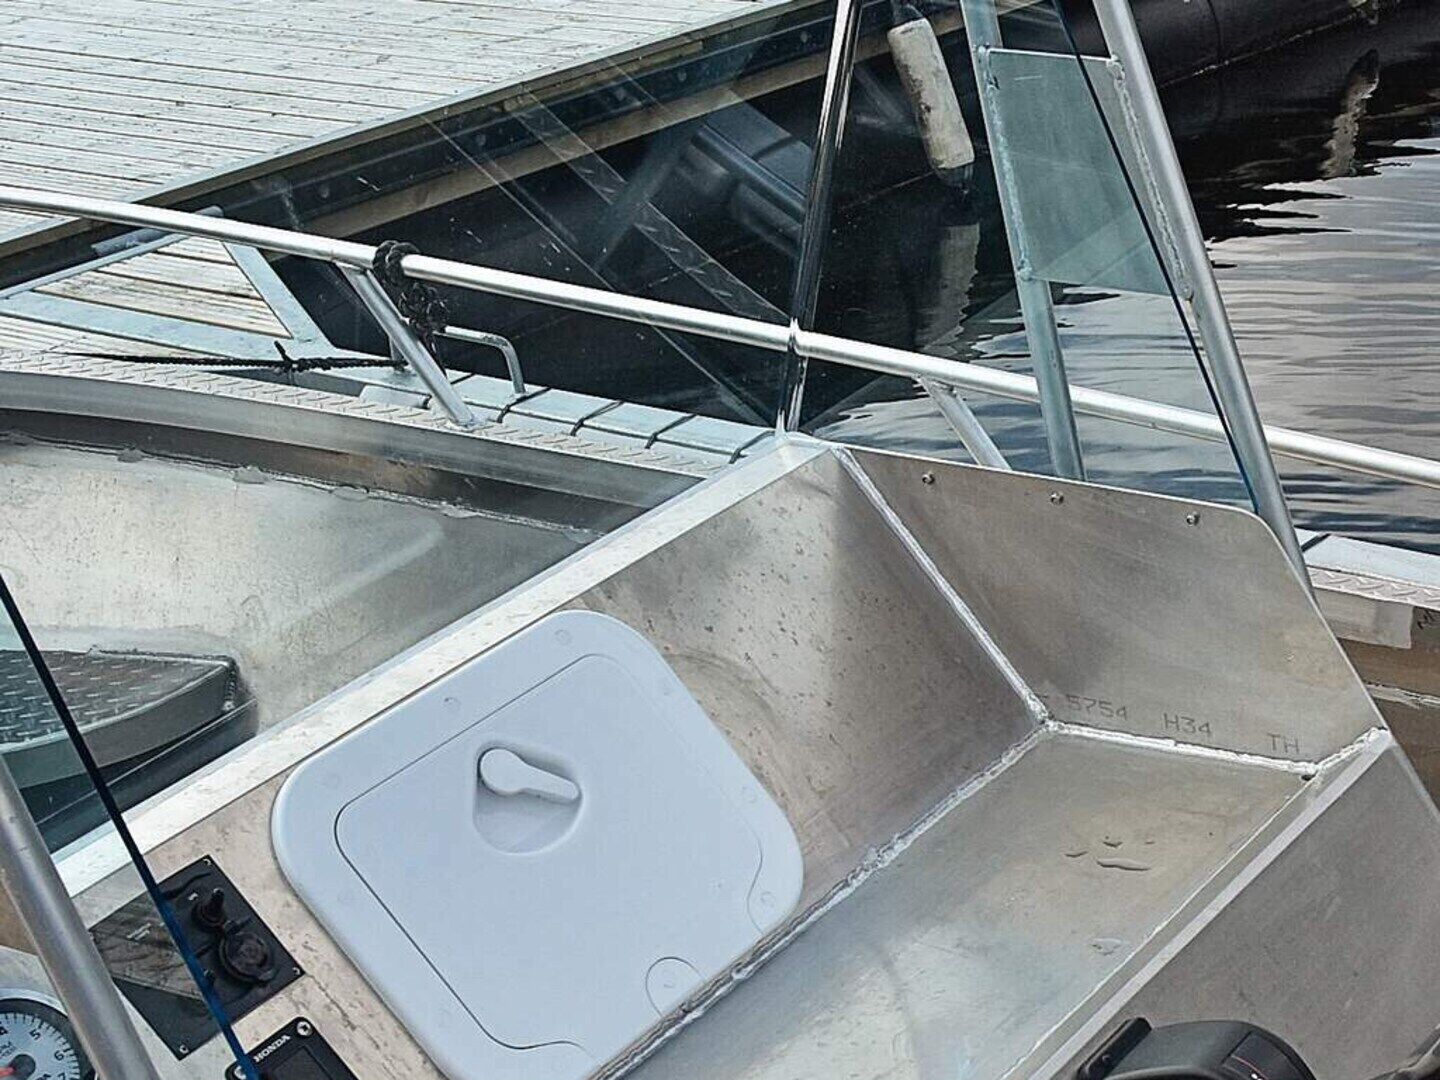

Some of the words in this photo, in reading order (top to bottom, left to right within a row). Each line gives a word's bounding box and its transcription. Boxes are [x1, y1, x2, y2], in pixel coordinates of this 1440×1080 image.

[1065, 693, 1128, 721] 5754
[1163, 712, 1213, 736] H34
[1267, 732, 1300, 752] TH
[29, 1028, 41, 1041] 5
[54, 1049, 64, 1061] 6
[253, 1034, 292, 1063] HONDA
